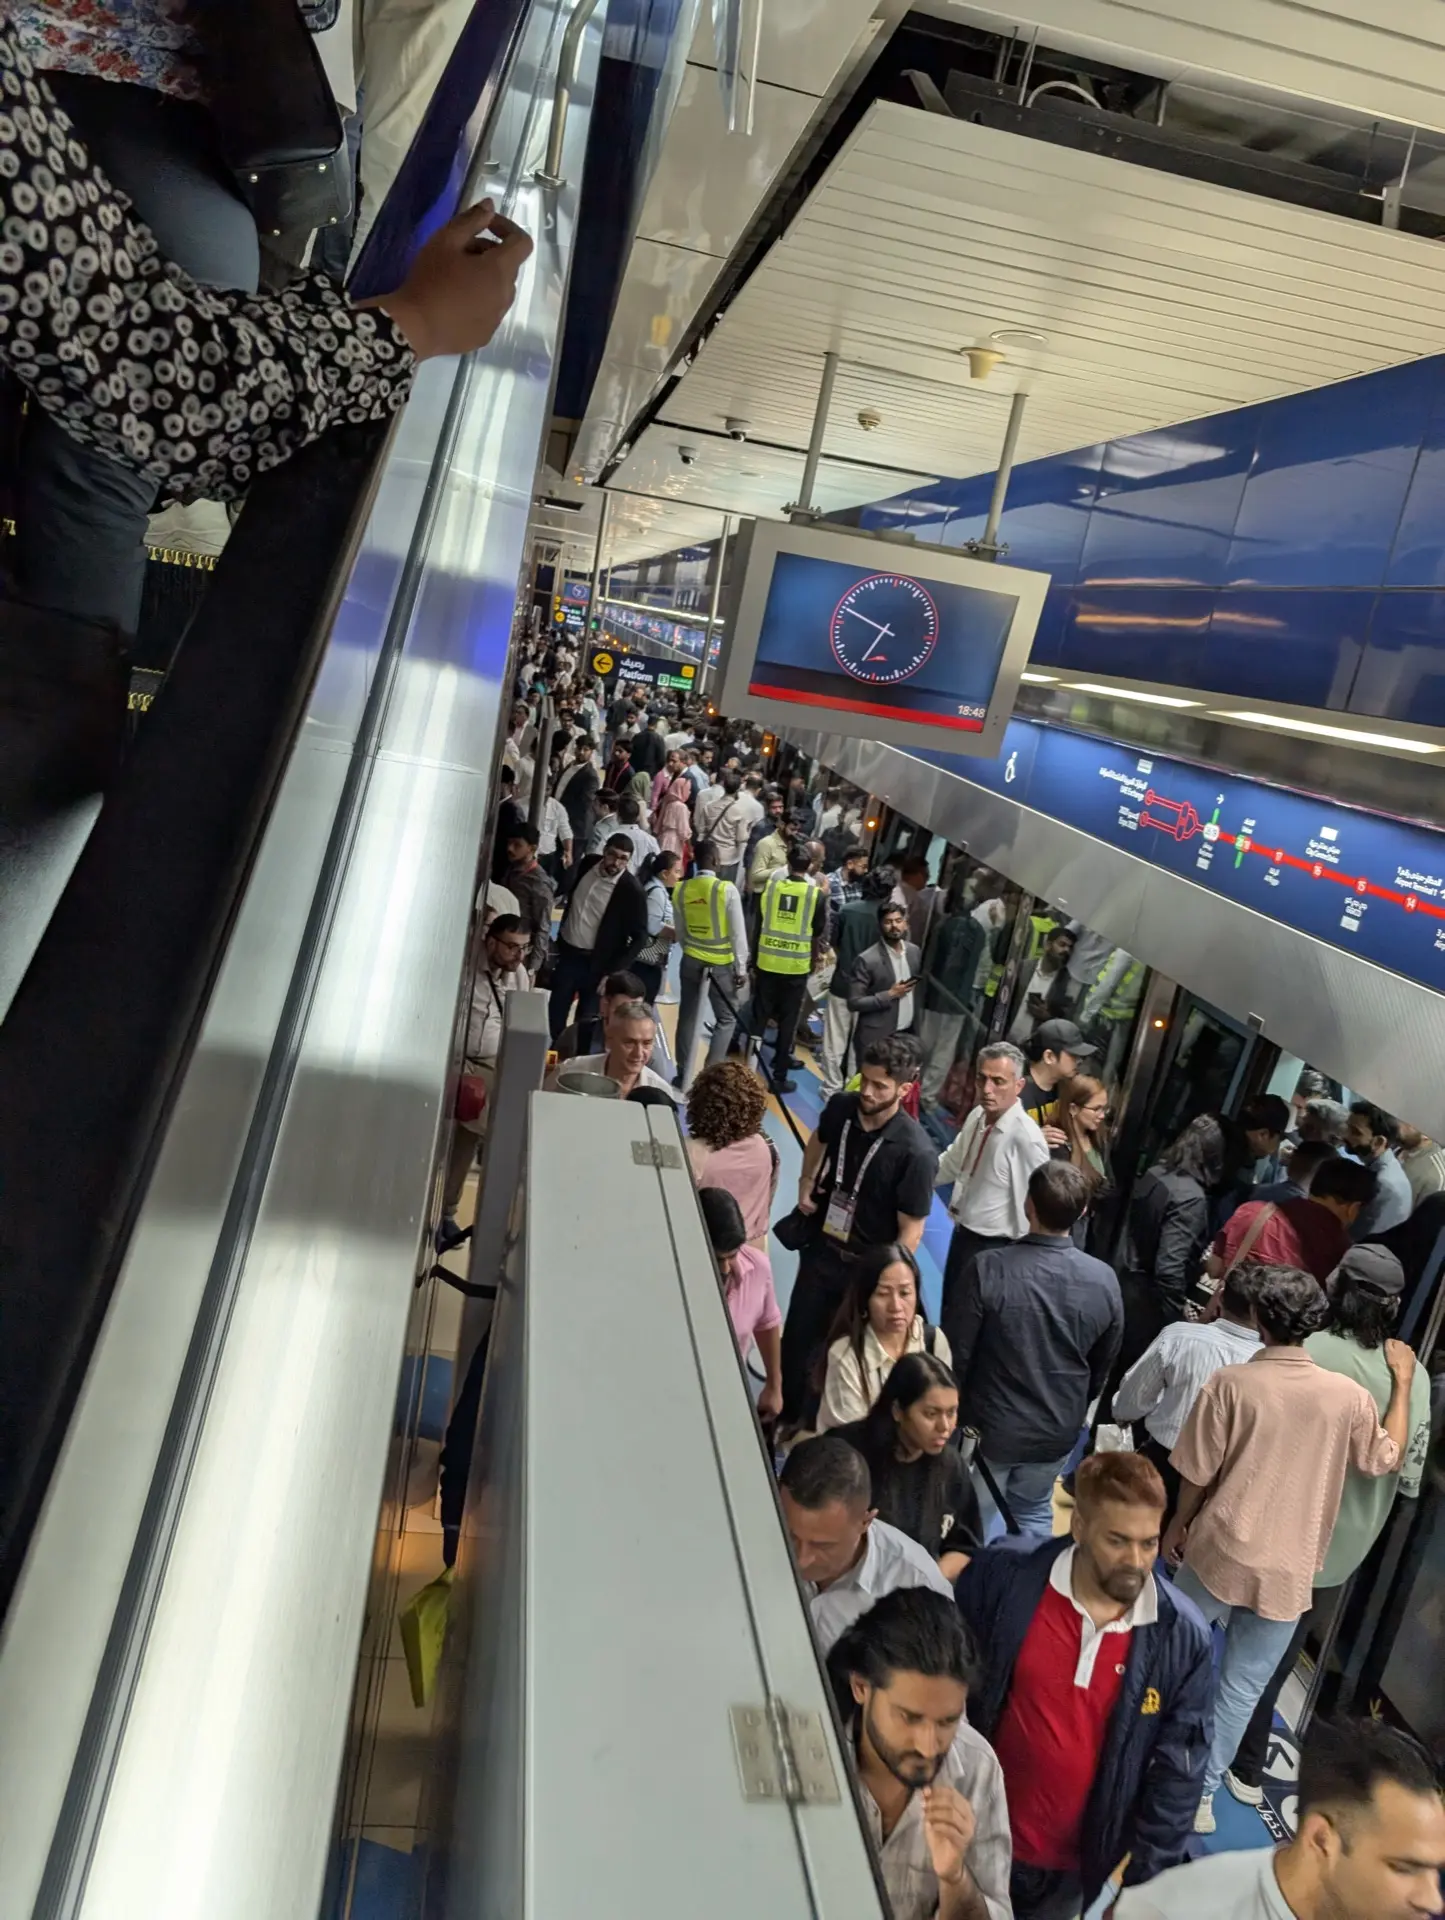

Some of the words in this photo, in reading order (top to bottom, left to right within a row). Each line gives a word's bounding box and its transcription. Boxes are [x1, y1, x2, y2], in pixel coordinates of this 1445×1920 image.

[621, 658, 645, 670] رصيف
[619, 668, 653, 682] Platform
[958, 705, 985, 718] 18:48
[1357, 881, 1366, 892] 15
[1407, 897, 1416, 907] 14
[765, 937, 800, 950] SECURITY
[1255, 1804, 1282, 1838] دخول
